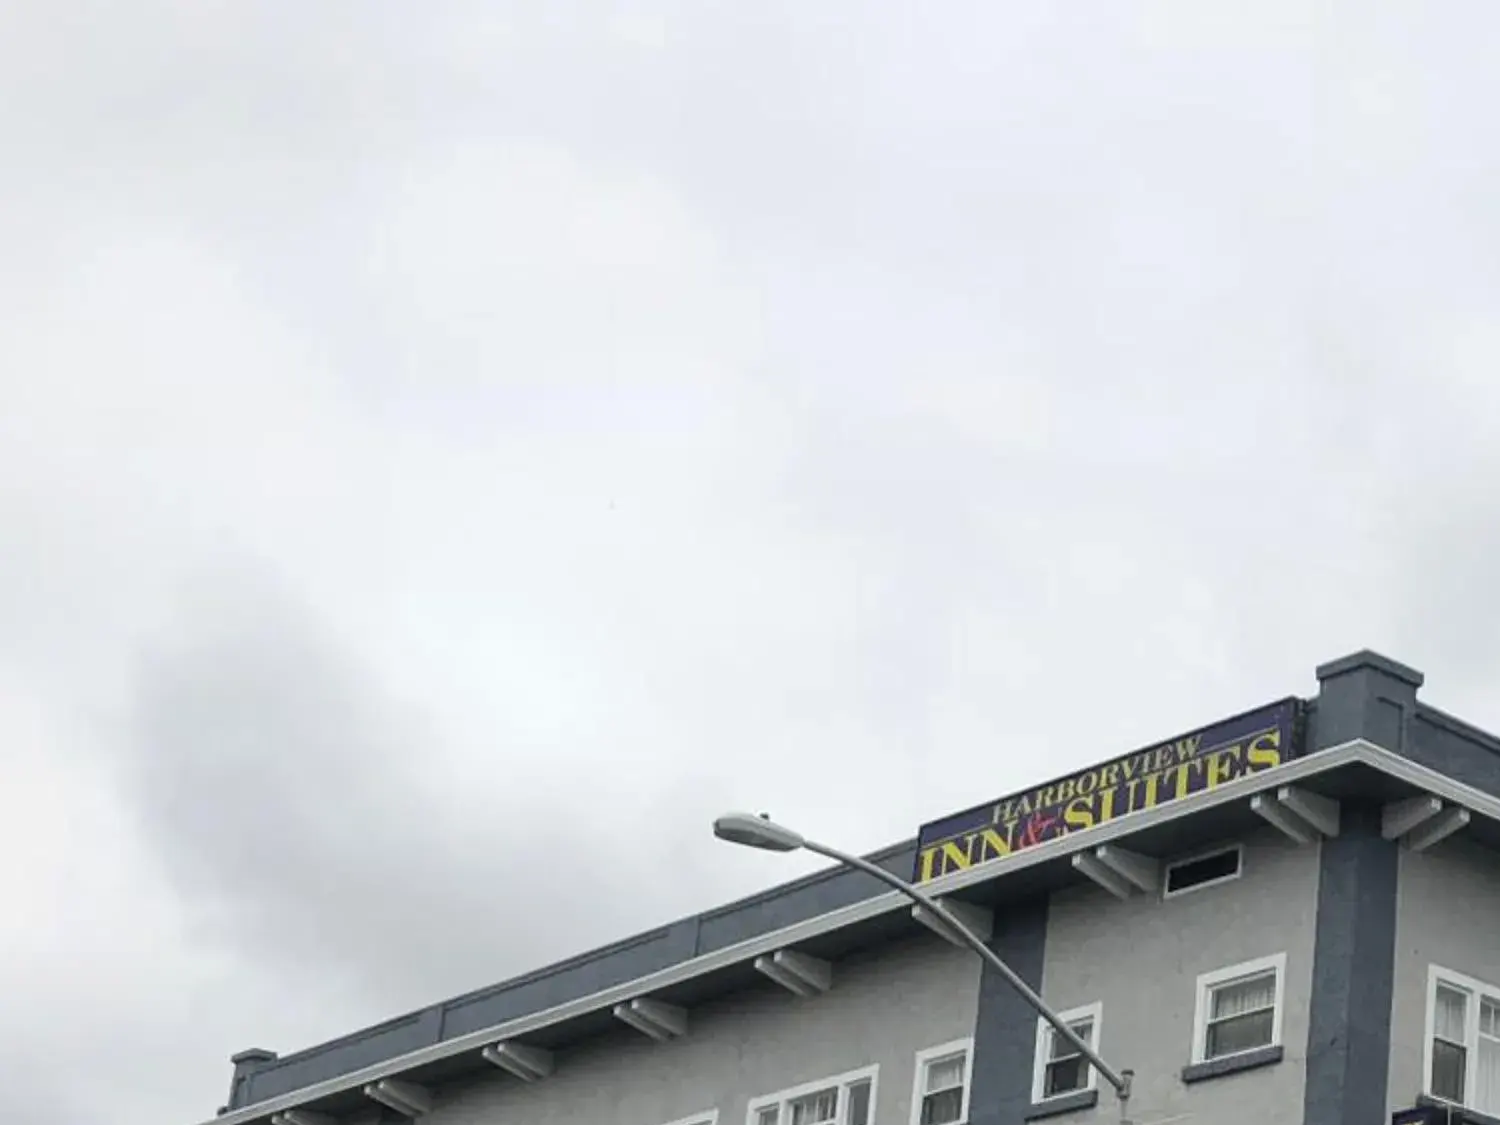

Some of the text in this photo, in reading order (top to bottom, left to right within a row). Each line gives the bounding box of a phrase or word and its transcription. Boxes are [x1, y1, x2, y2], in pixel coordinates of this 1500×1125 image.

[919, 729, 1281, 884] INN & SUITES
[993, 736, 1202, 824] HARBORVIEW
